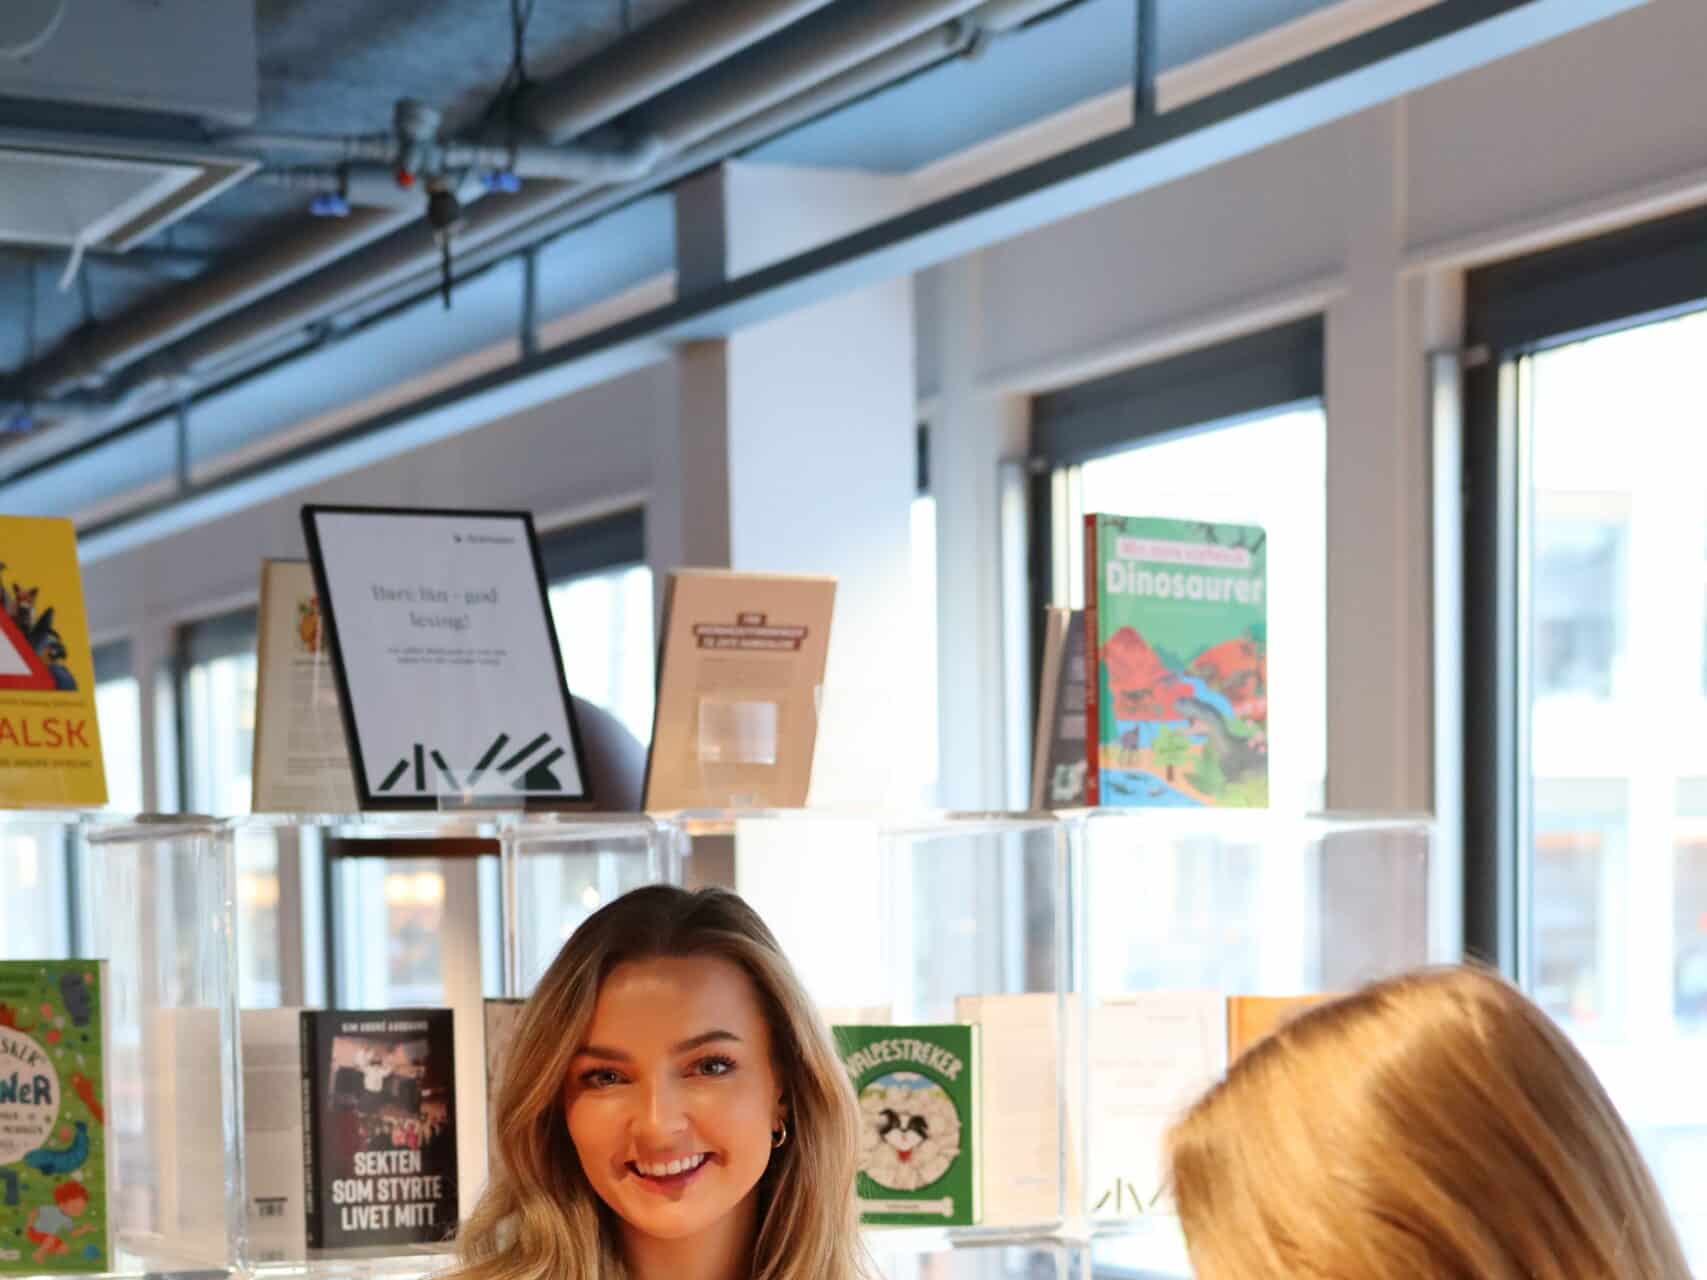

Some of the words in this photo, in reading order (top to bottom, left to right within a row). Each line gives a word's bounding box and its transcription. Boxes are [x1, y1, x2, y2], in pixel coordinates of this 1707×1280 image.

[1106, 559, 1264, 605] Dinosaurer
[353, 1150, 422, 1176] SEKTEN
[332, 1179, 373, 1205] SOM
[376, 1175, 443, 1202] STYRTE
[341, 1203, 393, 1231] LIVET
[394, 1202, 437, 1229] MITT
